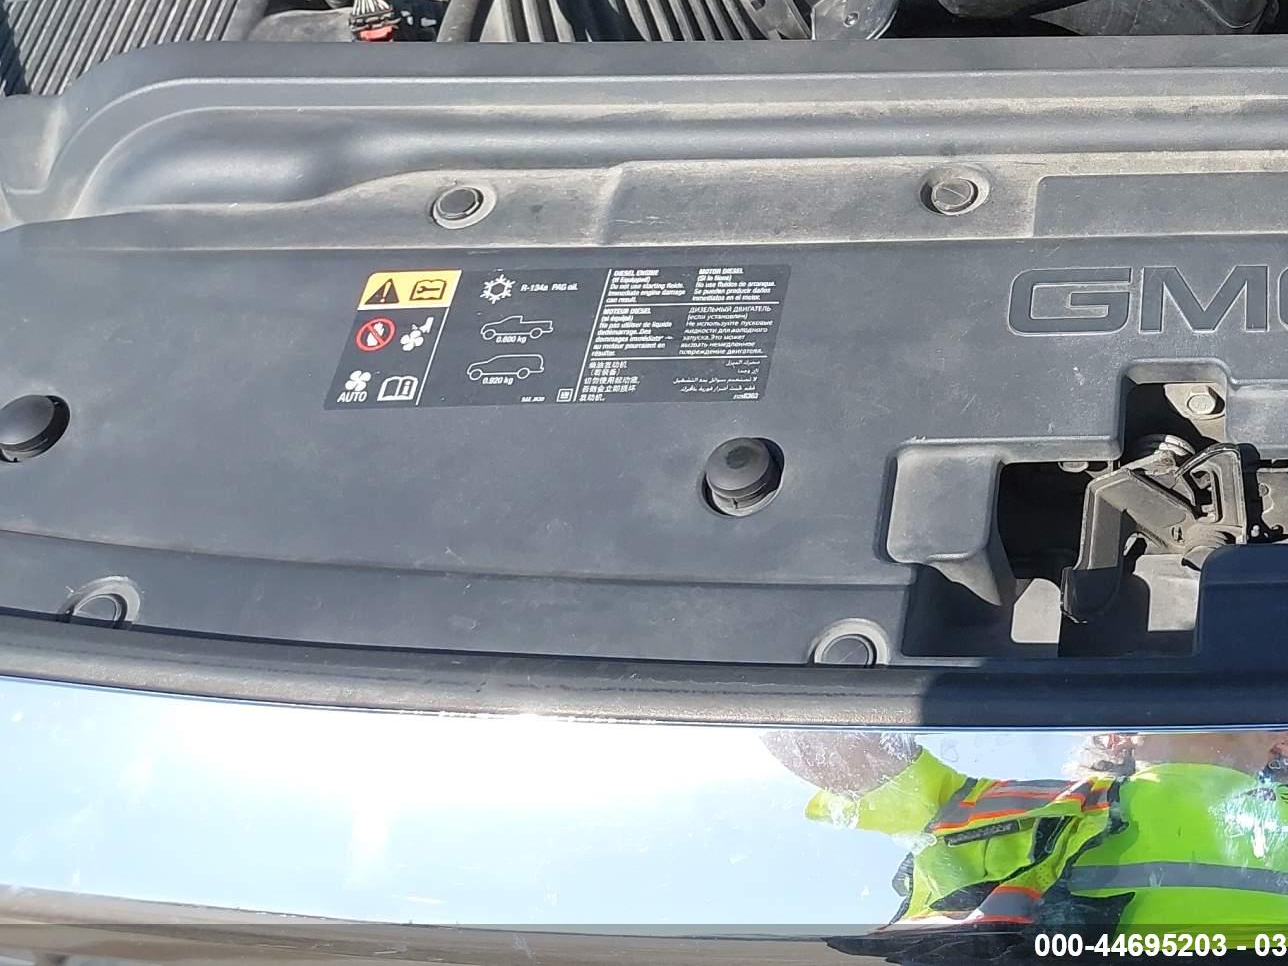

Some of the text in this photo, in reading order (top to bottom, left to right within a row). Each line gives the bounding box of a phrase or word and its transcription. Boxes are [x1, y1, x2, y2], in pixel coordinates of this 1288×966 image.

[520, 284, 548, 292] R-134a
[602, 307, 652, 315] MOTEUR DIESEL
[732, 305, 772, 313] ДВИГАТЕЛЬ
[608, 322, 620, 330] pas
[517, 336, 527, 344] kg
[504, 376, 514, 385] kg
[336, 391, 368, 402] AUTO
